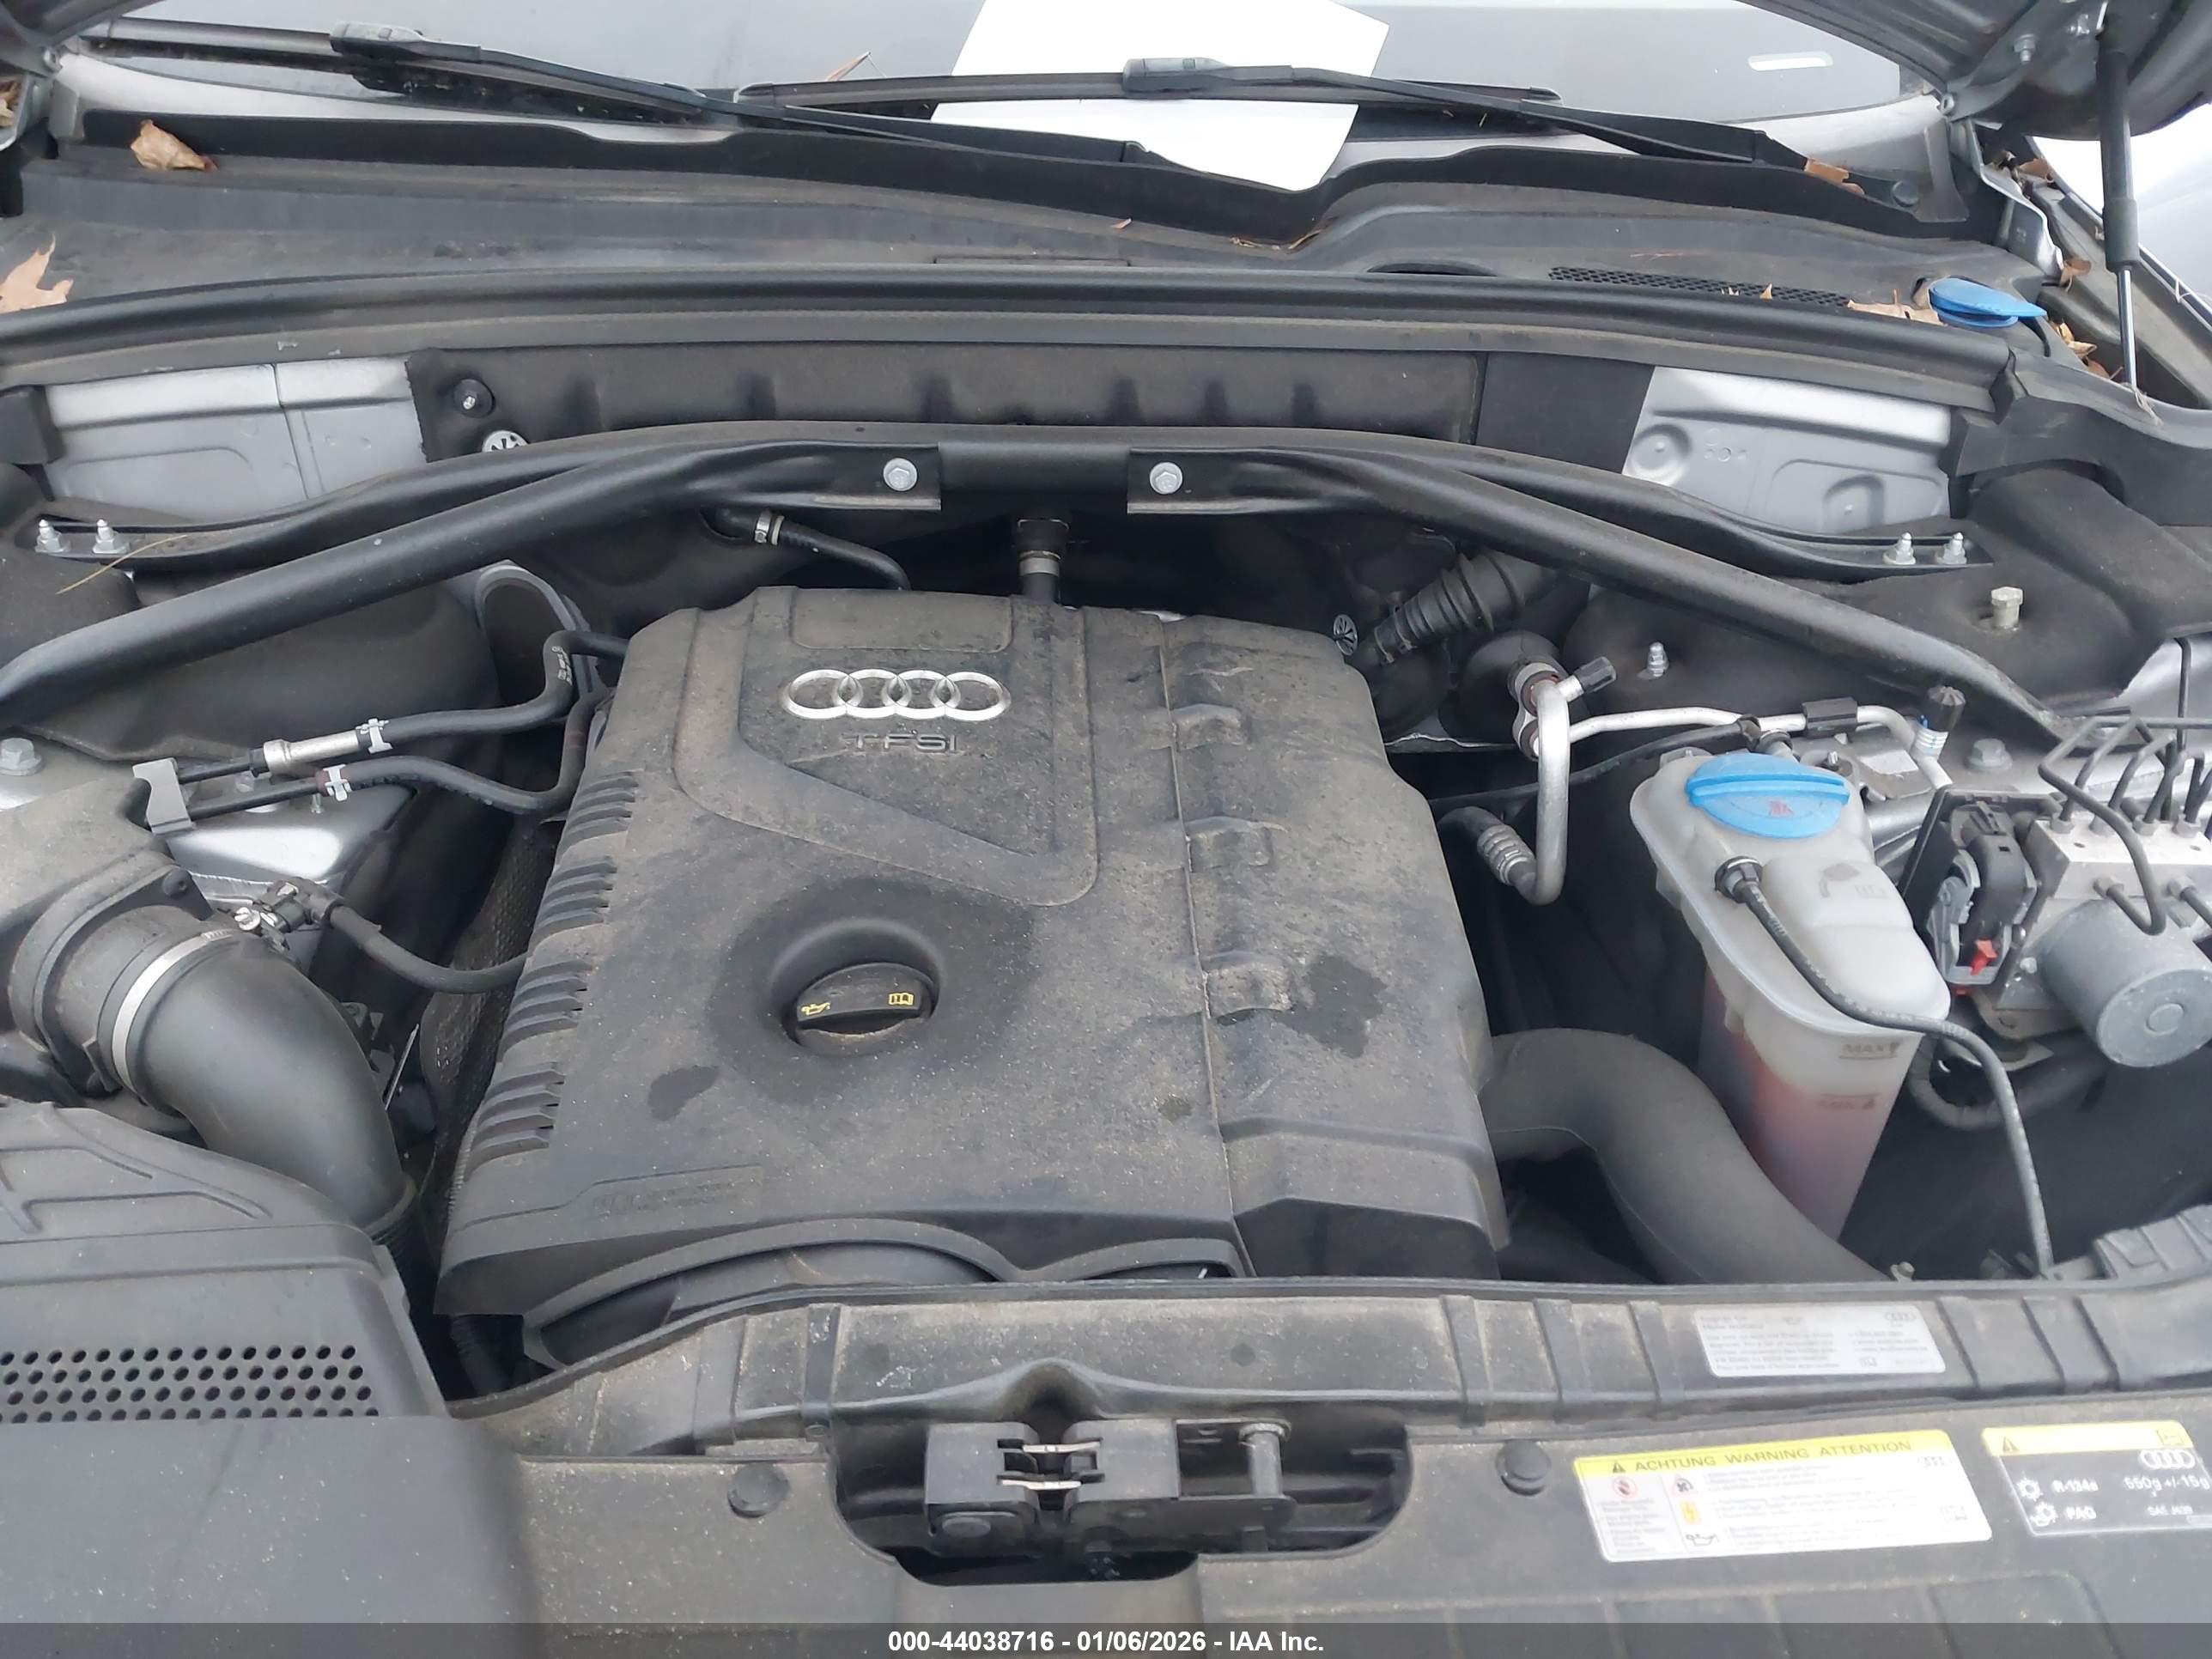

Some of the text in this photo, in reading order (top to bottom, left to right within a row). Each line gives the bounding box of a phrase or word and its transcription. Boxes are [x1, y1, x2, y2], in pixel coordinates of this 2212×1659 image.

[841, 731, 957, 753] TFSI
[1634, 1440, 1912, 1472] ACHTUNG WARNING ATTENTION
